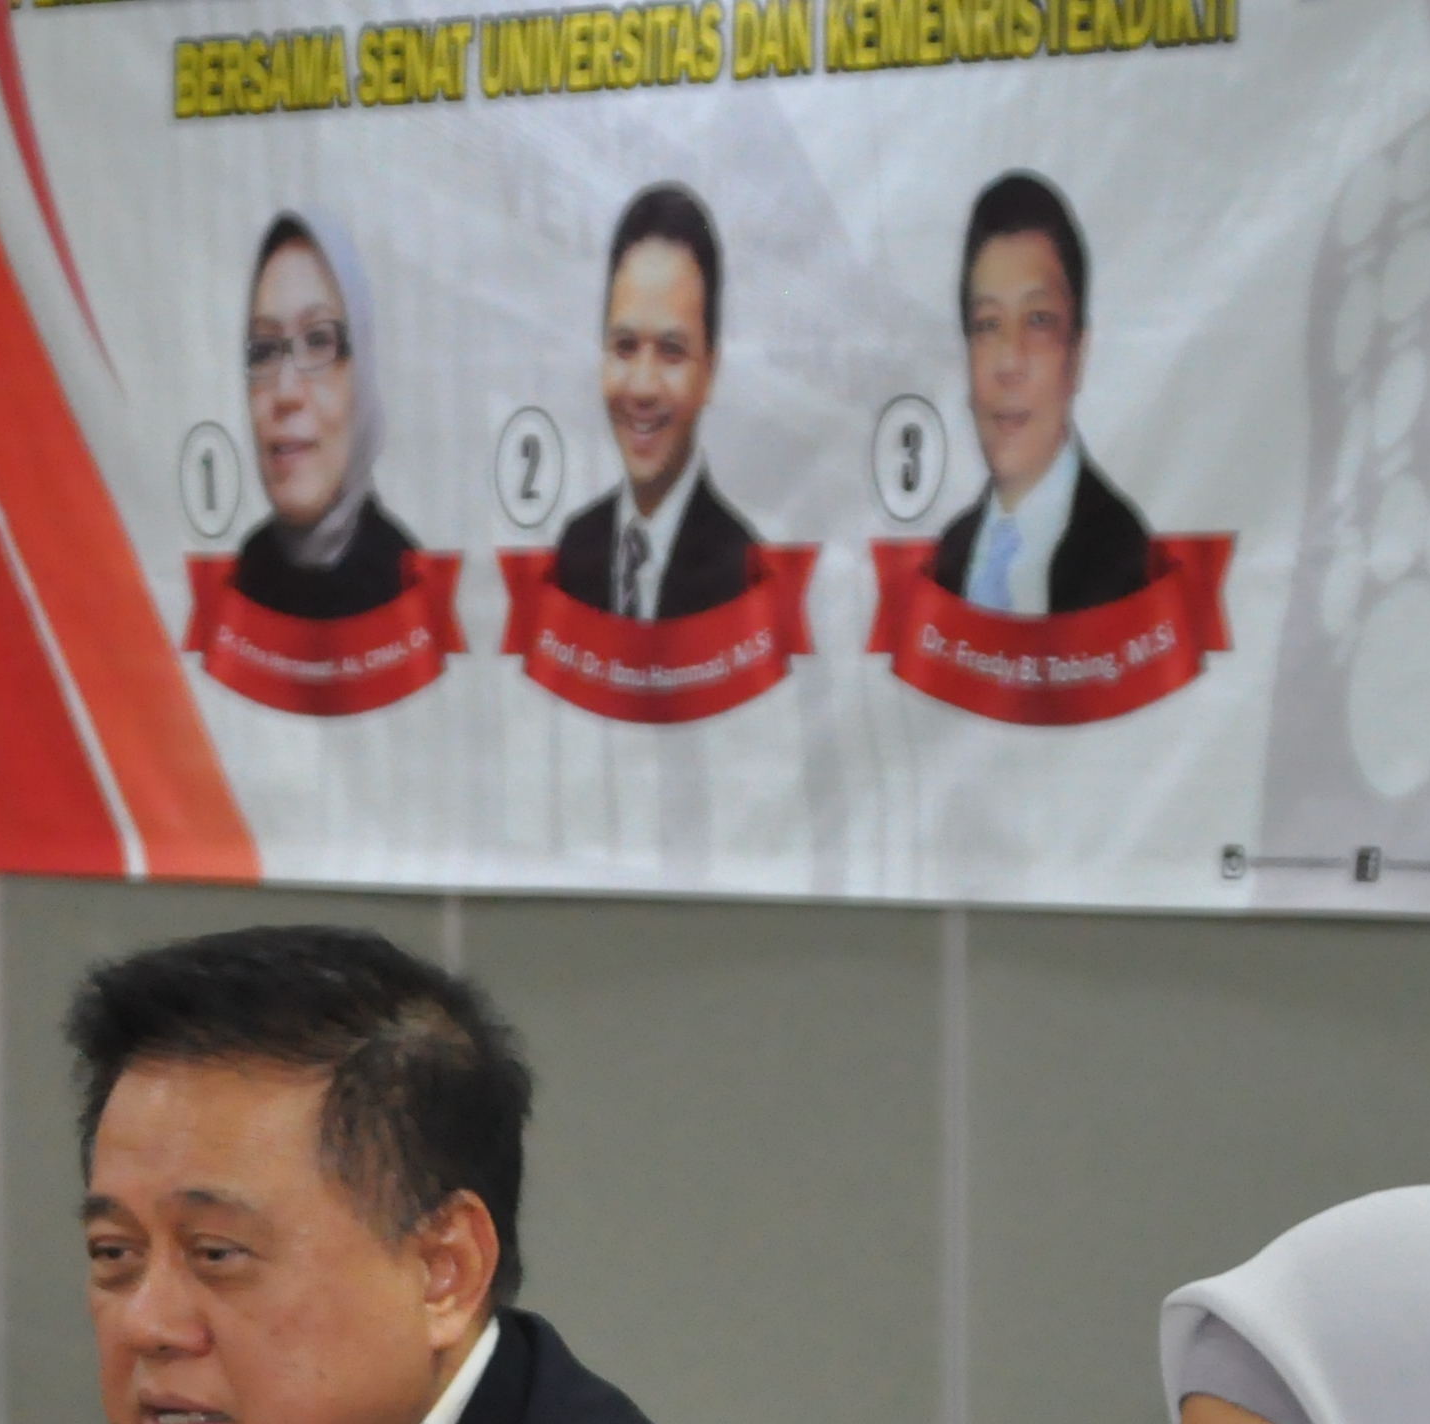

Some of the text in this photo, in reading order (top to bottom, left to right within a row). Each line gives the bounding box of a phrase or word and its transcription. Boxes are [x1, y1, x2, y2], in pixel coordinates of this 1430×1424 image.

[175, 25, 351, 118] BERSAMA
[358, 15, 474, 107] SENAT
[480, 2, 722, 99] UNIVERSITAS
[731, 0, 816, 81] DAN
[199, 447, 218, 512] 1
[519, 433, 542, 500] 2
[901, 422, 923, 493] 3
[921, 623, 949, 658] Dr.
